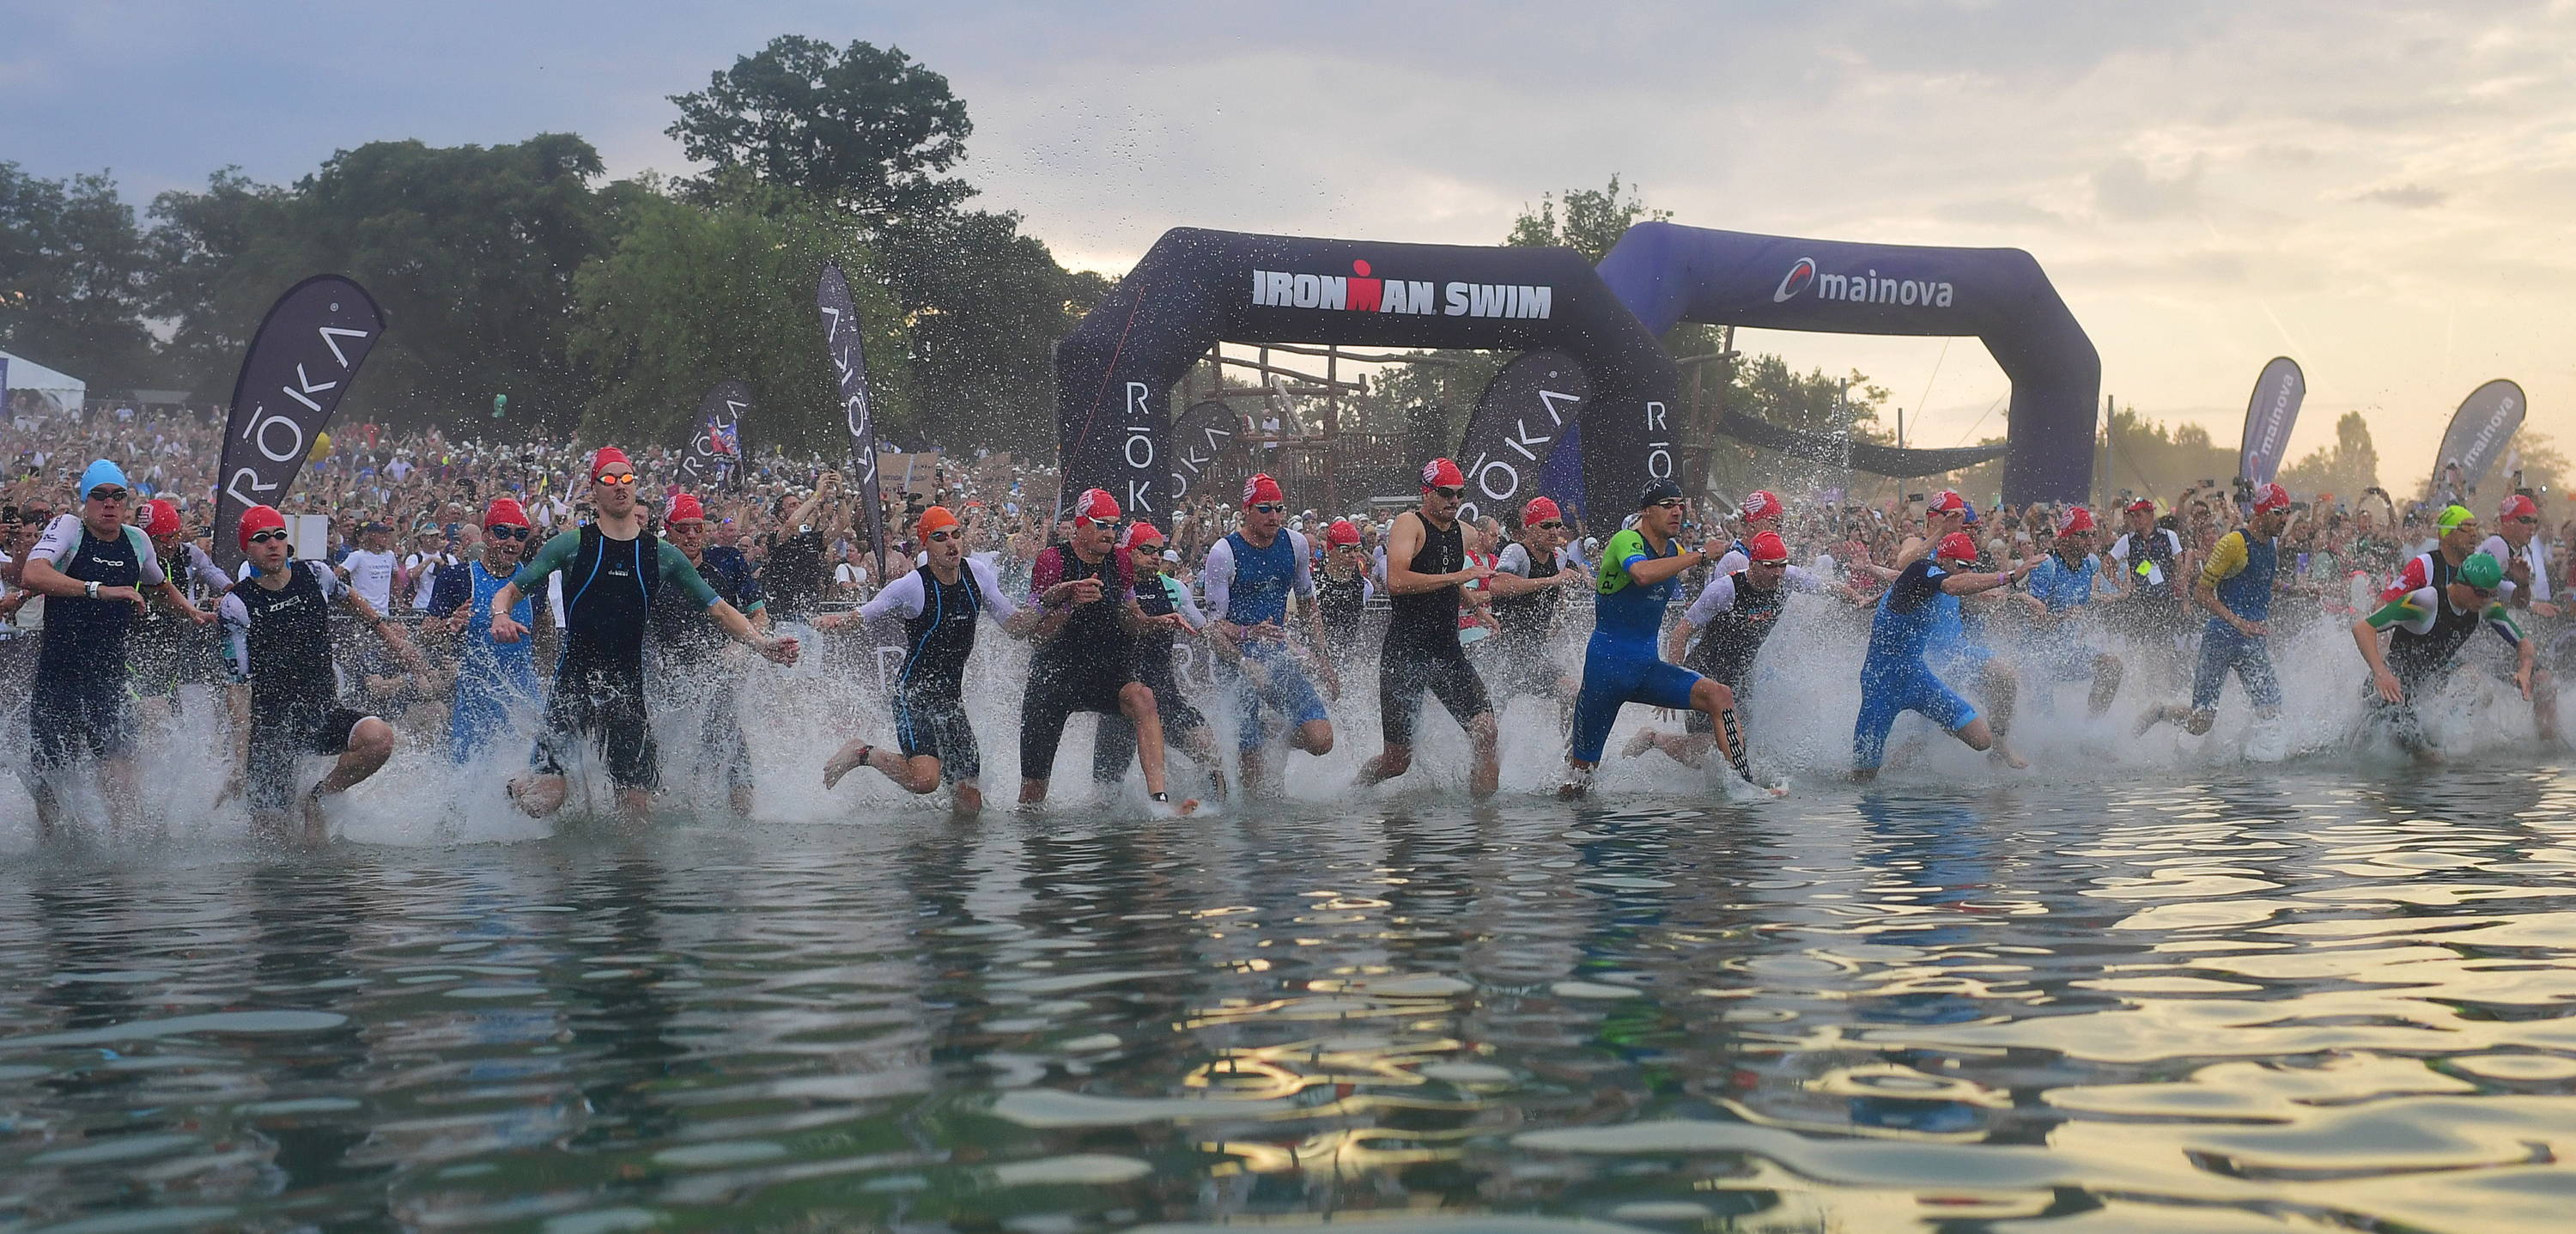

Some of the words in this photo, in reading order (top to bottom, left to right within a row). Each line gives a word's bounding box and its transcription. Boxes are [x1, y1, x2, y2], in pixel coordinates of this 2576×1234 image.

[1252, 259, 1435, 315] IRONMAN
[1444, 281, 1552, 319] SWIM
[1818, 269, 1953, 307] mainova
[2260, 374, 2294, 456] mainova
[2463, 396, 2515, 468] mainova
